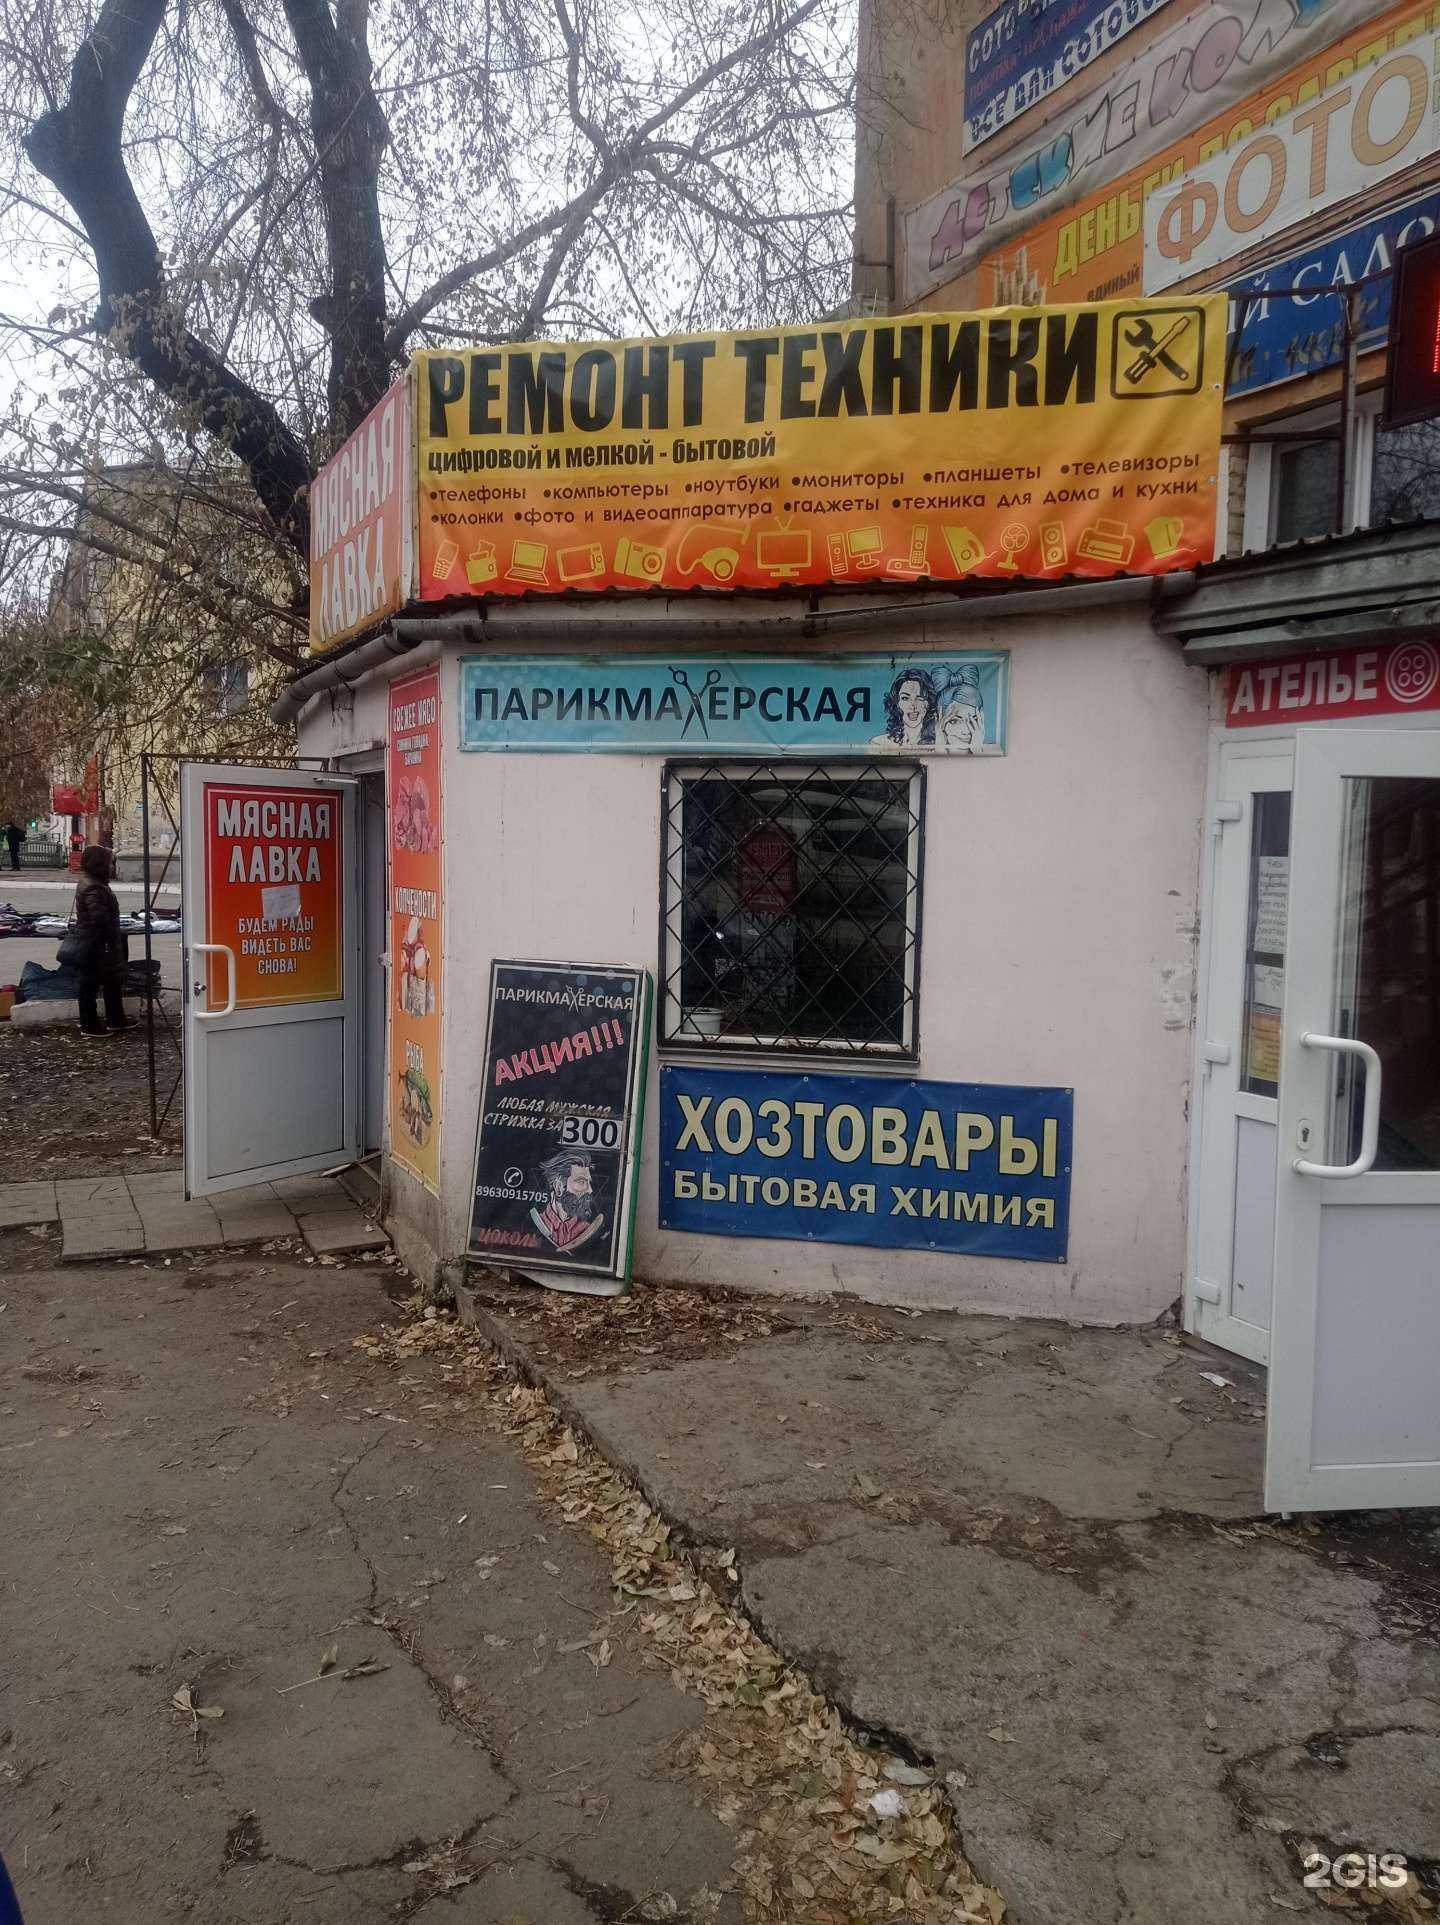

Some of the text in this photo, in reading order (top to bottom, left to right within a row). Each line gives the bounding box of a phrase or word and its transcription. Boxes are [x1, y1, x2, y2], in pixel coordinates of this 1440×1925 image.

[1157, 53, 1428, 264] ФОТО
[428, 312, 1099, 438] РЕМОНТ ТЕХНИКИ
[428, 444, 542, 474] цифровой
[547, 448, 561, 469] и
[565, 438, 654, 469] мелкой
[672, 431, 776, 465] бытовой
[315, 398, 395, 561] МЯСНАЯ
[437, 453, 1199, 504] телефоны компьютеры ноутбуки мониторы планшеты телевизоры
[440, 479, 1198, 527] колонки фото и видеоаппаратура гаджеты техника для дома и кухни
[320, 517, 387, 642] ЛАВКА
[474, 670, 871, 733] ПАРИКМАХЕРСКАЯ
[1231, 652, 1378, 715] АТЕЛЬЕ
[217, 798, 330, 839] МЯСНАЯ
[228, 845, 321, 883] ЛАВКА
[395, 886, 437, 920] КОПЧЕНОСТИ
[238, 916, 314, 935] БУДЕМ РАДЫ
[241, 937, 311, 955] ВИДЕТЬ ВАС
[257, 958, 298, 974] СНОВА!
[495, 985, 634, 1012] ПАРИКМАХЕРСКАЯ
[495, 1018, 625, 1086] АКЦИЯ!!!
[496, 1096, 545, 1113] ЛЮБАЯ
[483, 1112, 544, 1131] СТРИЖКА
[563, 1116, 618, 1147] 300
[675, 1094, 1059, 1178] ХОЗТОВАРЫ
[475, 1185, 548, 1204] 89630915705
[673, 1169, 1056, 1230] БЫТОВАЯ ХИМИЯ
[477, 1228, 539, 1248] ЦОКОЛЬ
